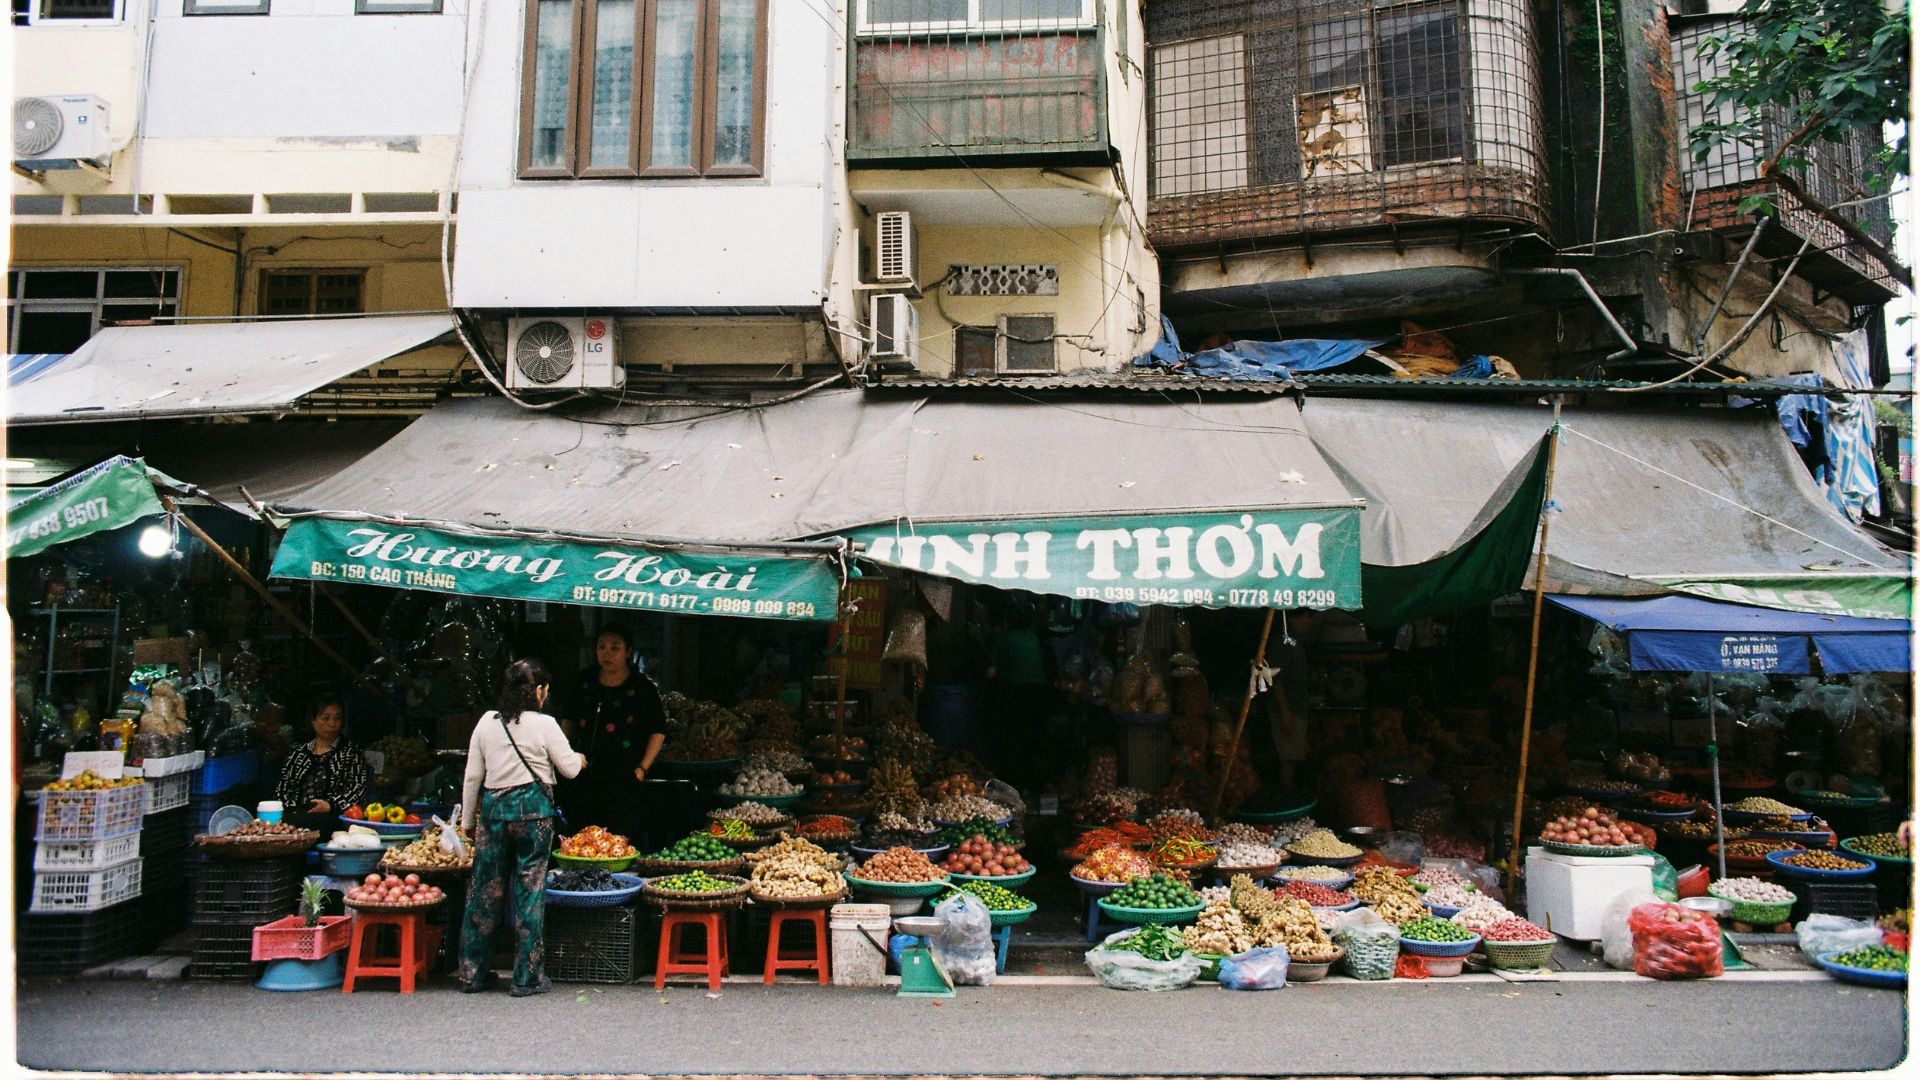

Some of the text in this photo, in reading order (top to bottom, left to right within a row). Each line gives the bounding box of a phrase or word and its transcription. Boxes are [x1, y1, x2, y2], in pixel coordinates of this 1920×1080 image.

[587, 342, 603, 353] LG
[64, 497, 109, 528] 9507
[1076, 514, 1325, 580] THƠM
[346, 528, 759, 592] Hương Hoài
[369, 565, 401, 583] CAO
[599, 588, 654, 606] 097771
[659, 593, 698, 609] 6177
[713, 597, 751, 613] 0989
[1104, 587, 1135, 601] 039
[1139, 588, 1179, 603] 5942
[1183, 589, 1214, 604] 094
[1229, 589, 1269, 606] 0778
[1273, 589, 1293, 606] 49
[1297, 590, 1336, 606] 8299
